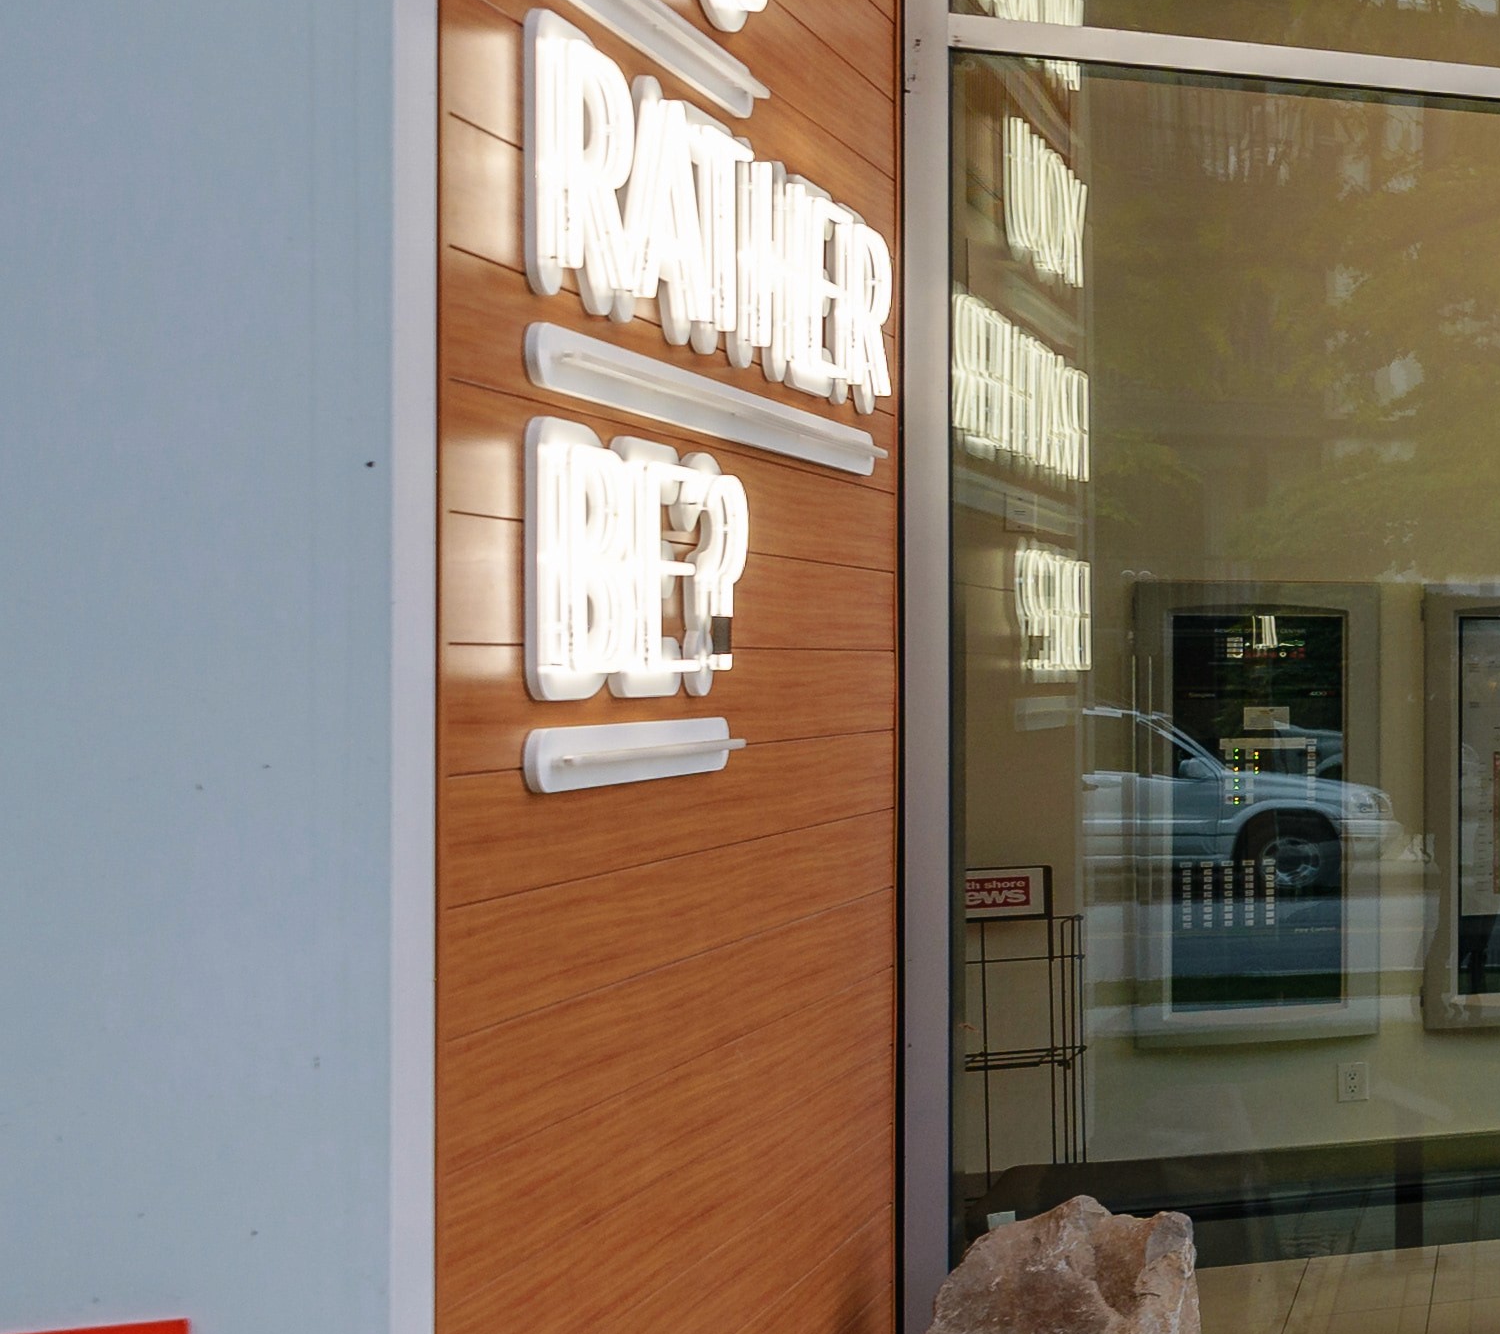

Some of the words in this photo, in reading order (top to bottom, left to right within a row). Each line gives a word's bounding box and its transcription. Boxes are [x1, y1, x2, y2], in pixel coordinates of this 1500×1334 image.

[523, 7, 893, 415] RATHER
[524, 415, 749, 701] BE?
[966, 889, 1027, 906] ews
[983, 880, 1026, 889] shore
